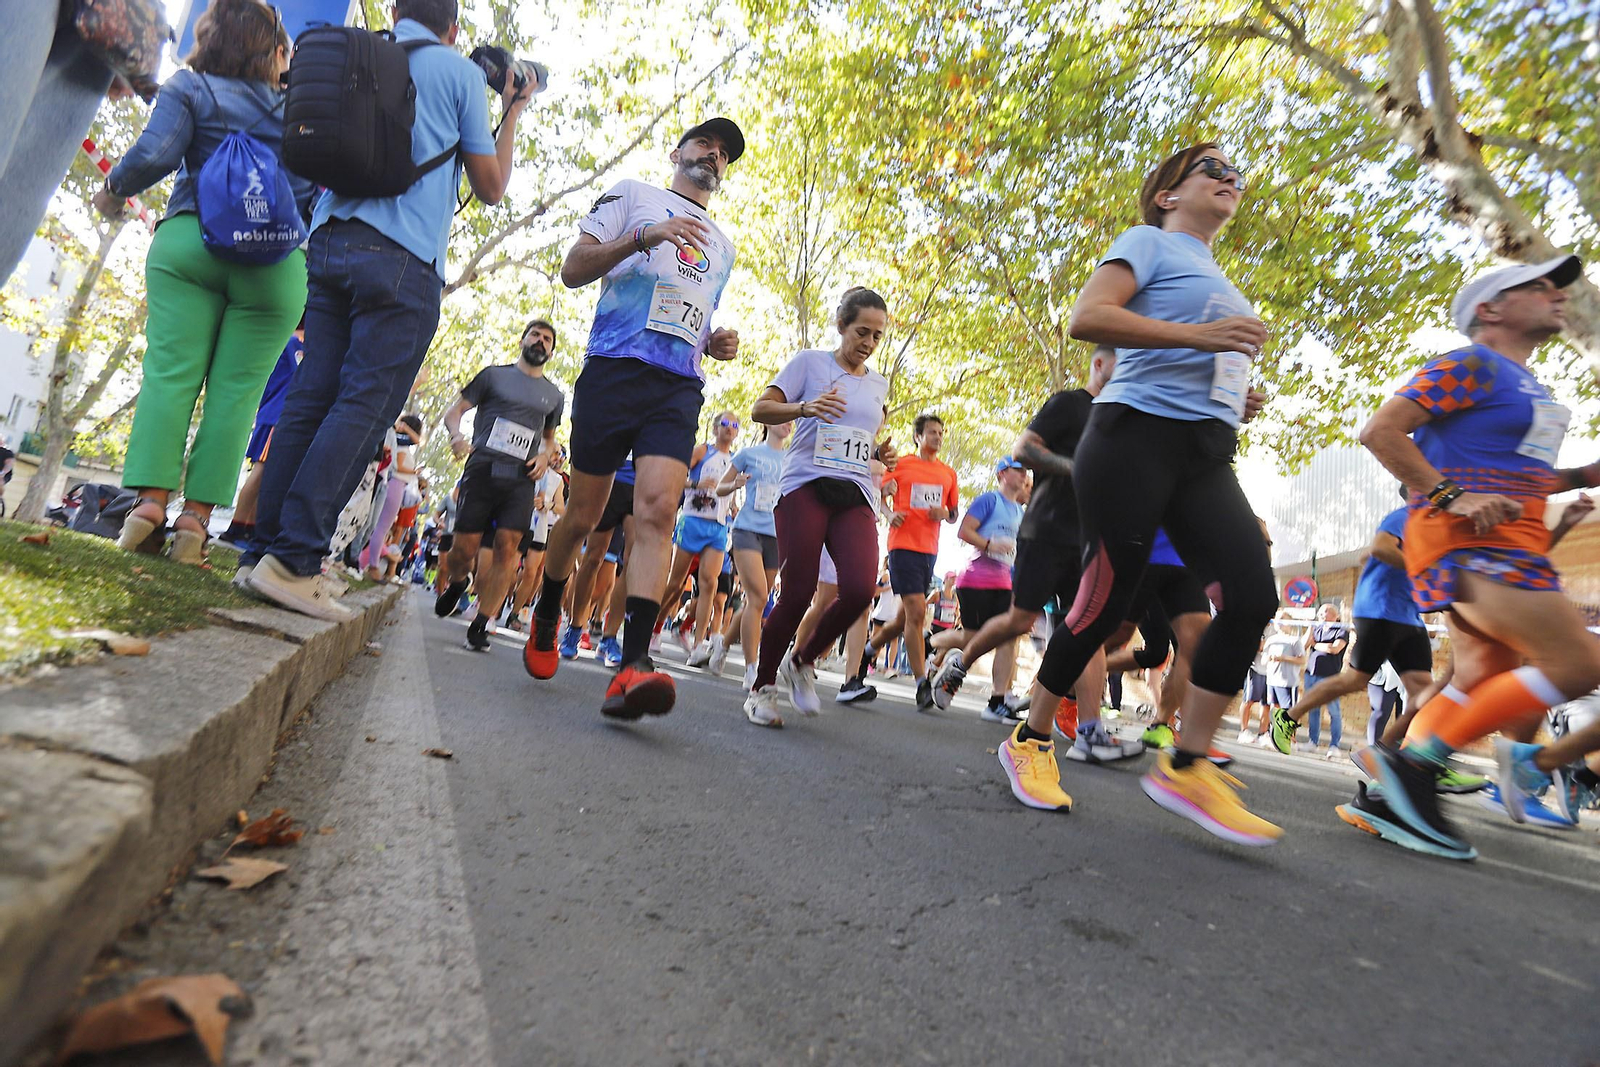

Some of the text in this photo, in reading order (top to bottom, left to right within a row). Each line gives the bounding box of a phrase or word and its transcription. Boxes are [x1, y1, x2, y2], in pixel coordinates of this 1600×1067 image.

[678, 264, 702, 283] WiHu
[681, 301, 704, 331] 750
[843, 438, 870, 462] 113
